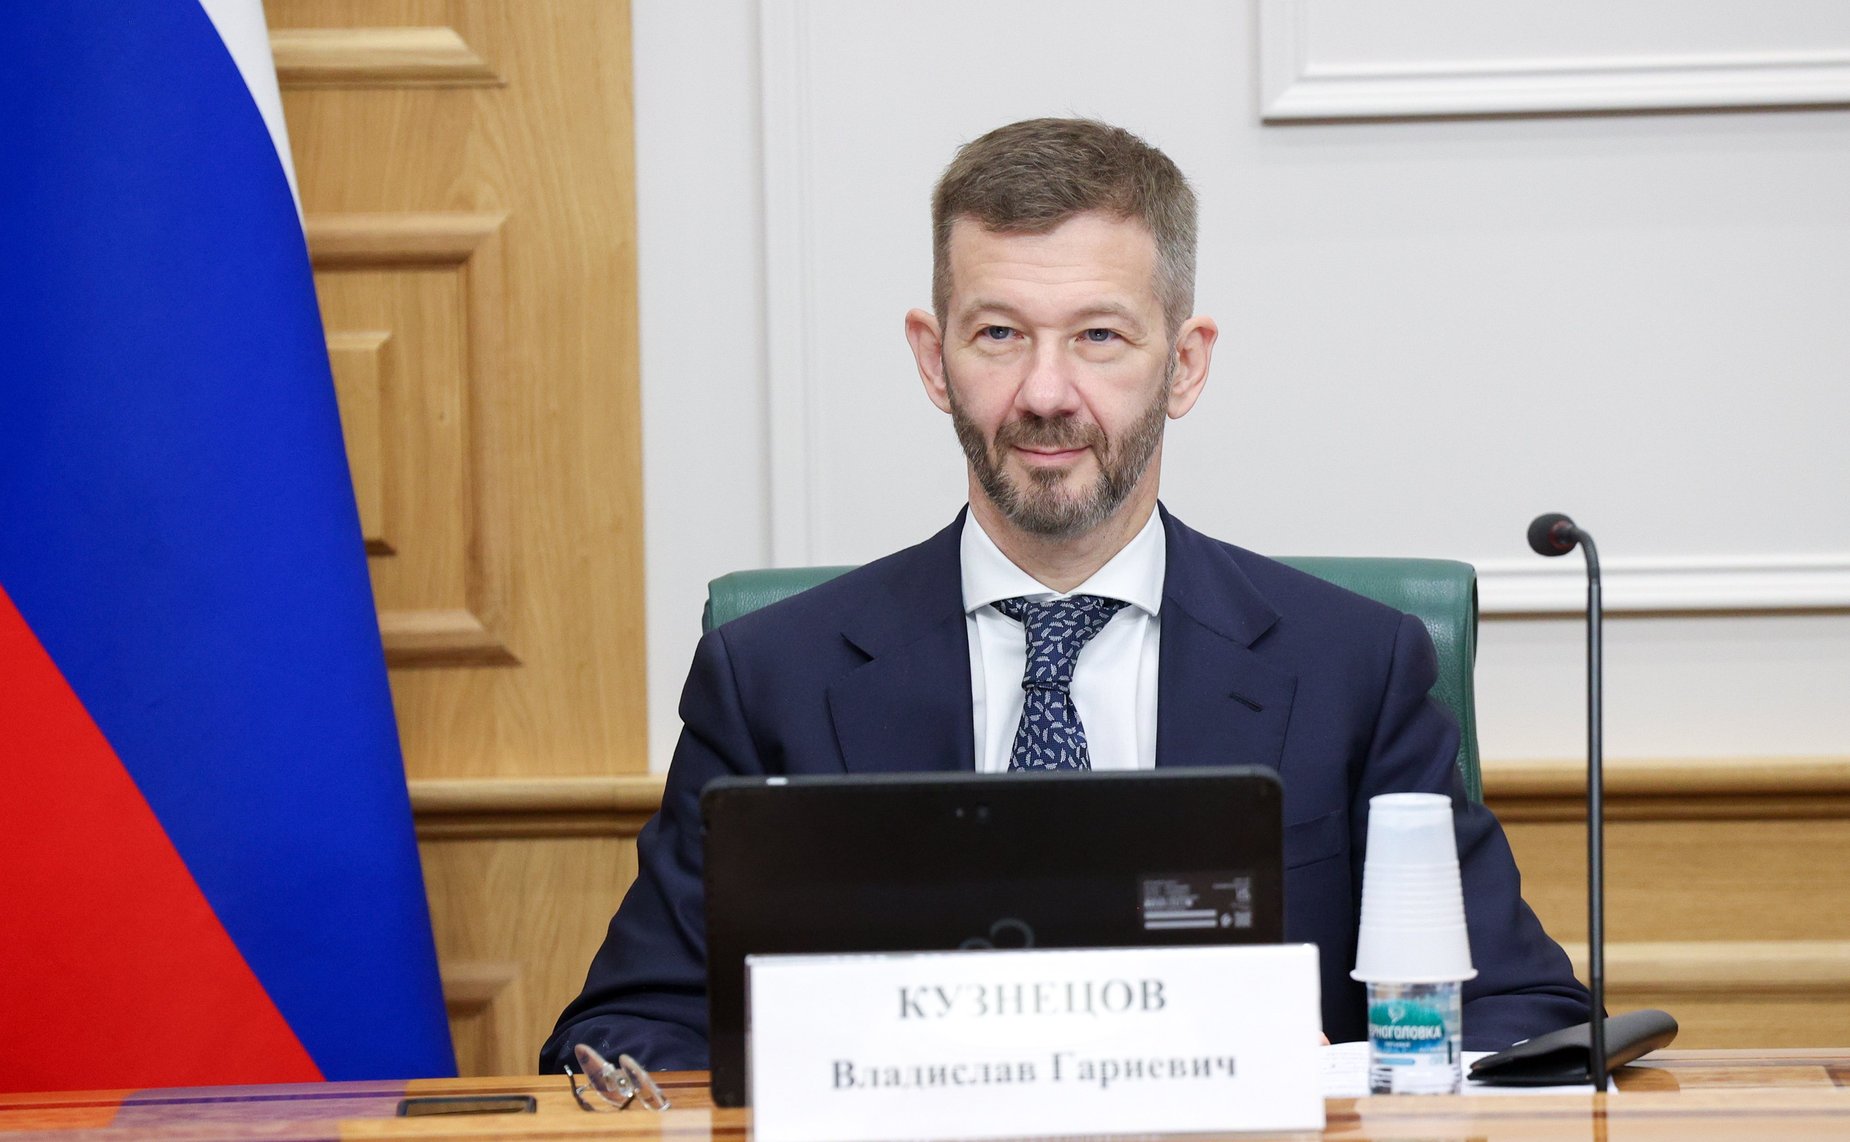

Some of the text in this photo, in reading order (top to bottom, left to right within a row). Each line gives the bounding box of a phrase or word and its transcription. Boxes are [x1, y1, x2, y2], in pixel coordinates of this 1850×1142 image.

[897, 978, 1166, 1020] КУЗНЕЦОВ
[831, 1052, 1237, 1090] Владислав Гариевич
